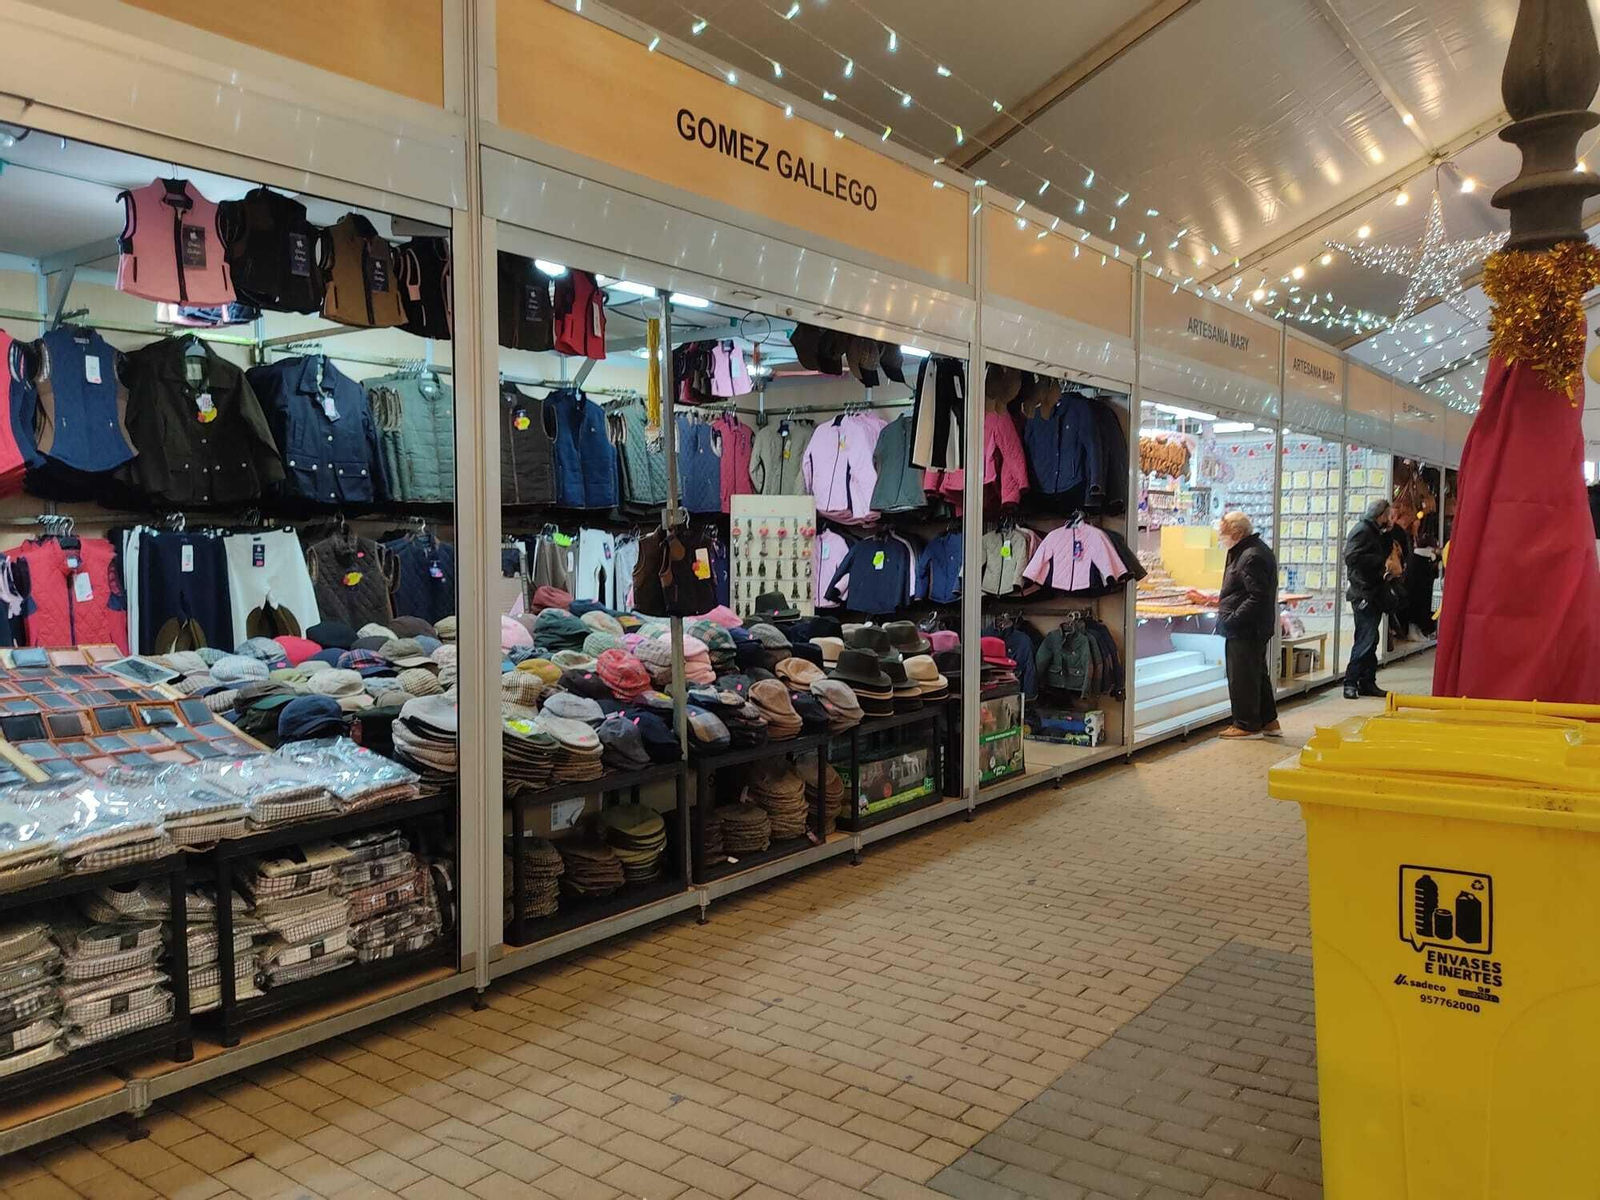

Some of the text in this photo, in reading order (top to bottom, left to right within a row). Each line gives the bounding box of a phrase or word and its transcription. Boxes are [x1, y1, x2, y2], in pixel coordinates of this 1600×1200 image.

[677, 109, 877, 211] GOMEZ GALLEGO
[1187, 317, 1250, 352] ARTESANIA MARY
[1427, 950, 1502, 974] ENVASES
[1410, 980, 1446, 992] sadeco
[1425, 962, 1503, 987] E INERTES
[1420, 994, 1480, 1013] 957762000
